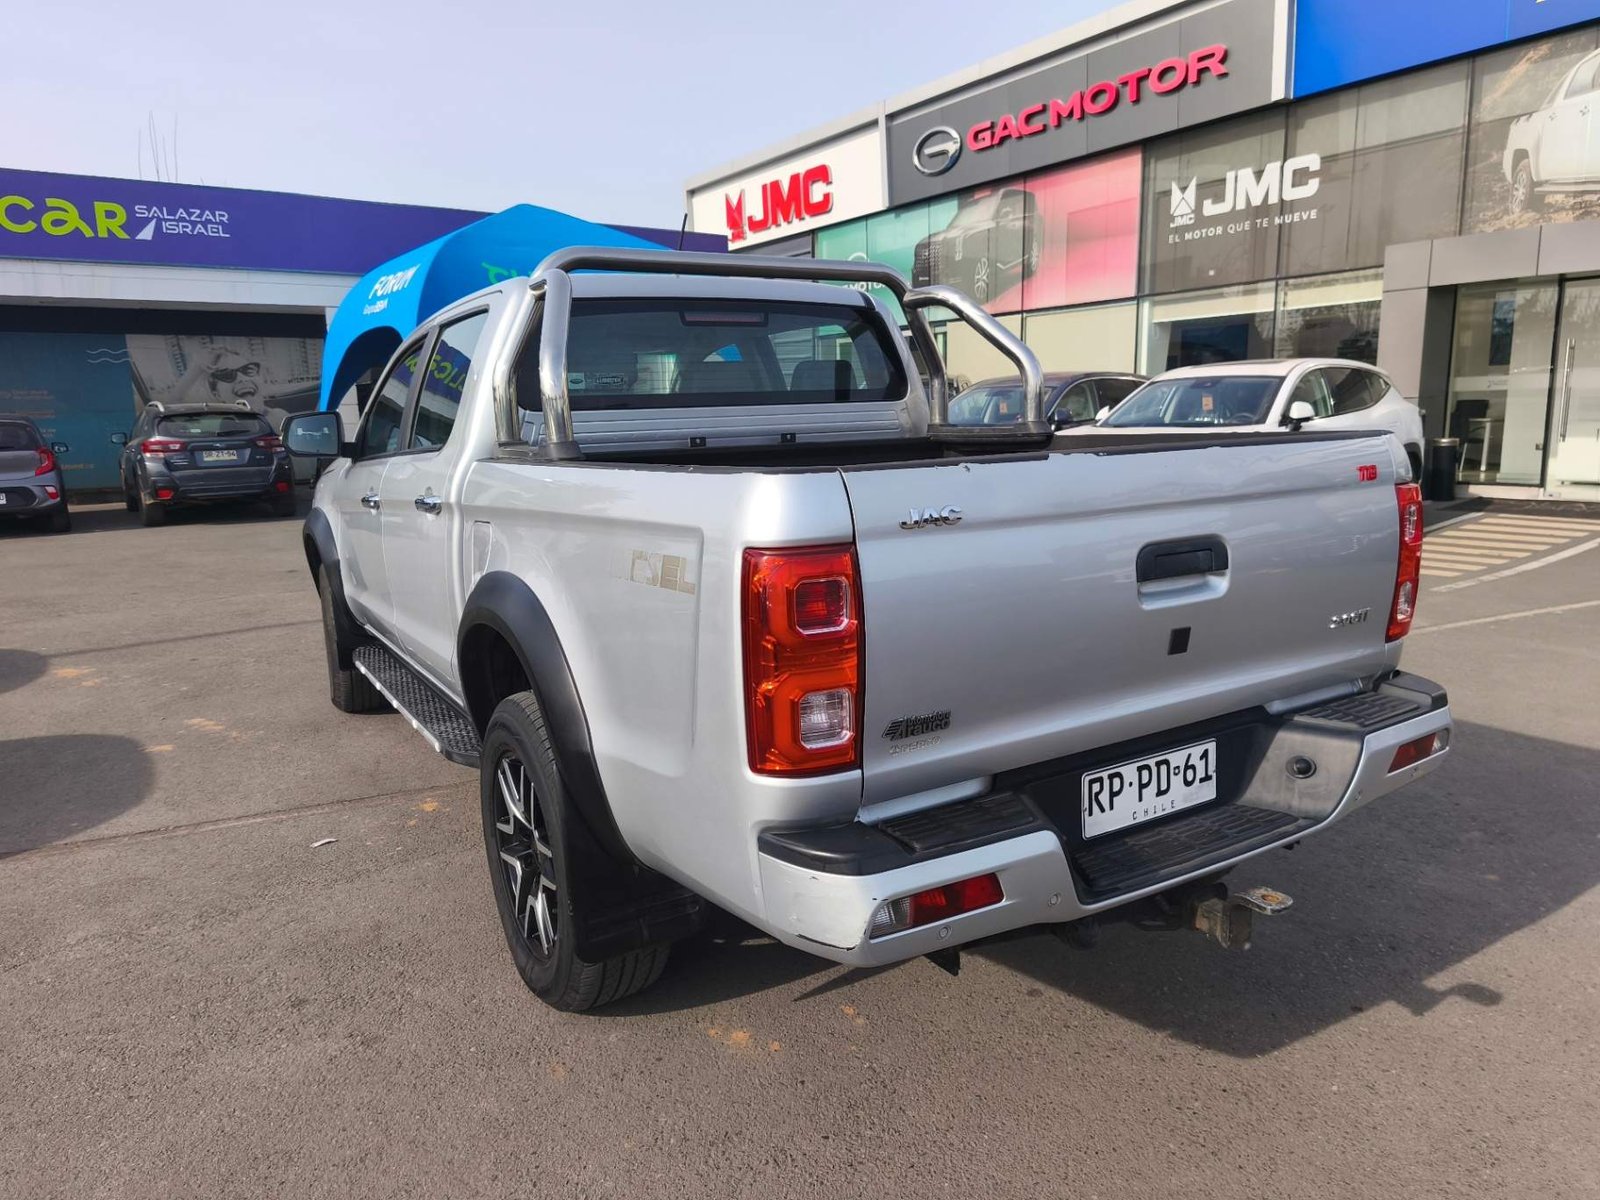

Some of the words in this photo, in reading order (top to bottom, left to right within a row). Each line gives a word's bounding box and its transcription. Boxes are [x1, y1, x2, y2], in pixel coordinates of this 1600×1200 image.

[965, 103, 1047, 152] GAC
[1049, 43, 1230, 128] MOTOR
[1202, 153, 1321, 217] JMC
[747, 164, 833, 234] JMC
[135, 205, 229, 223] SALAZAR
[1168, 234, 1181, 244] EL
[1184, 226, 1223, 241] MOTOR
[1227, 220, 1251, 234] QUE
[1255, 217, 1269, 228] TE
[1274, 208, 1318, 226] MUEVE
[1169, 213, 1195, 228] JMC
[162, 220, 231, 238] ISRAEL
[898, 504, 963, 530] JAC
[1132, 799, 1176, 821] CHILE
